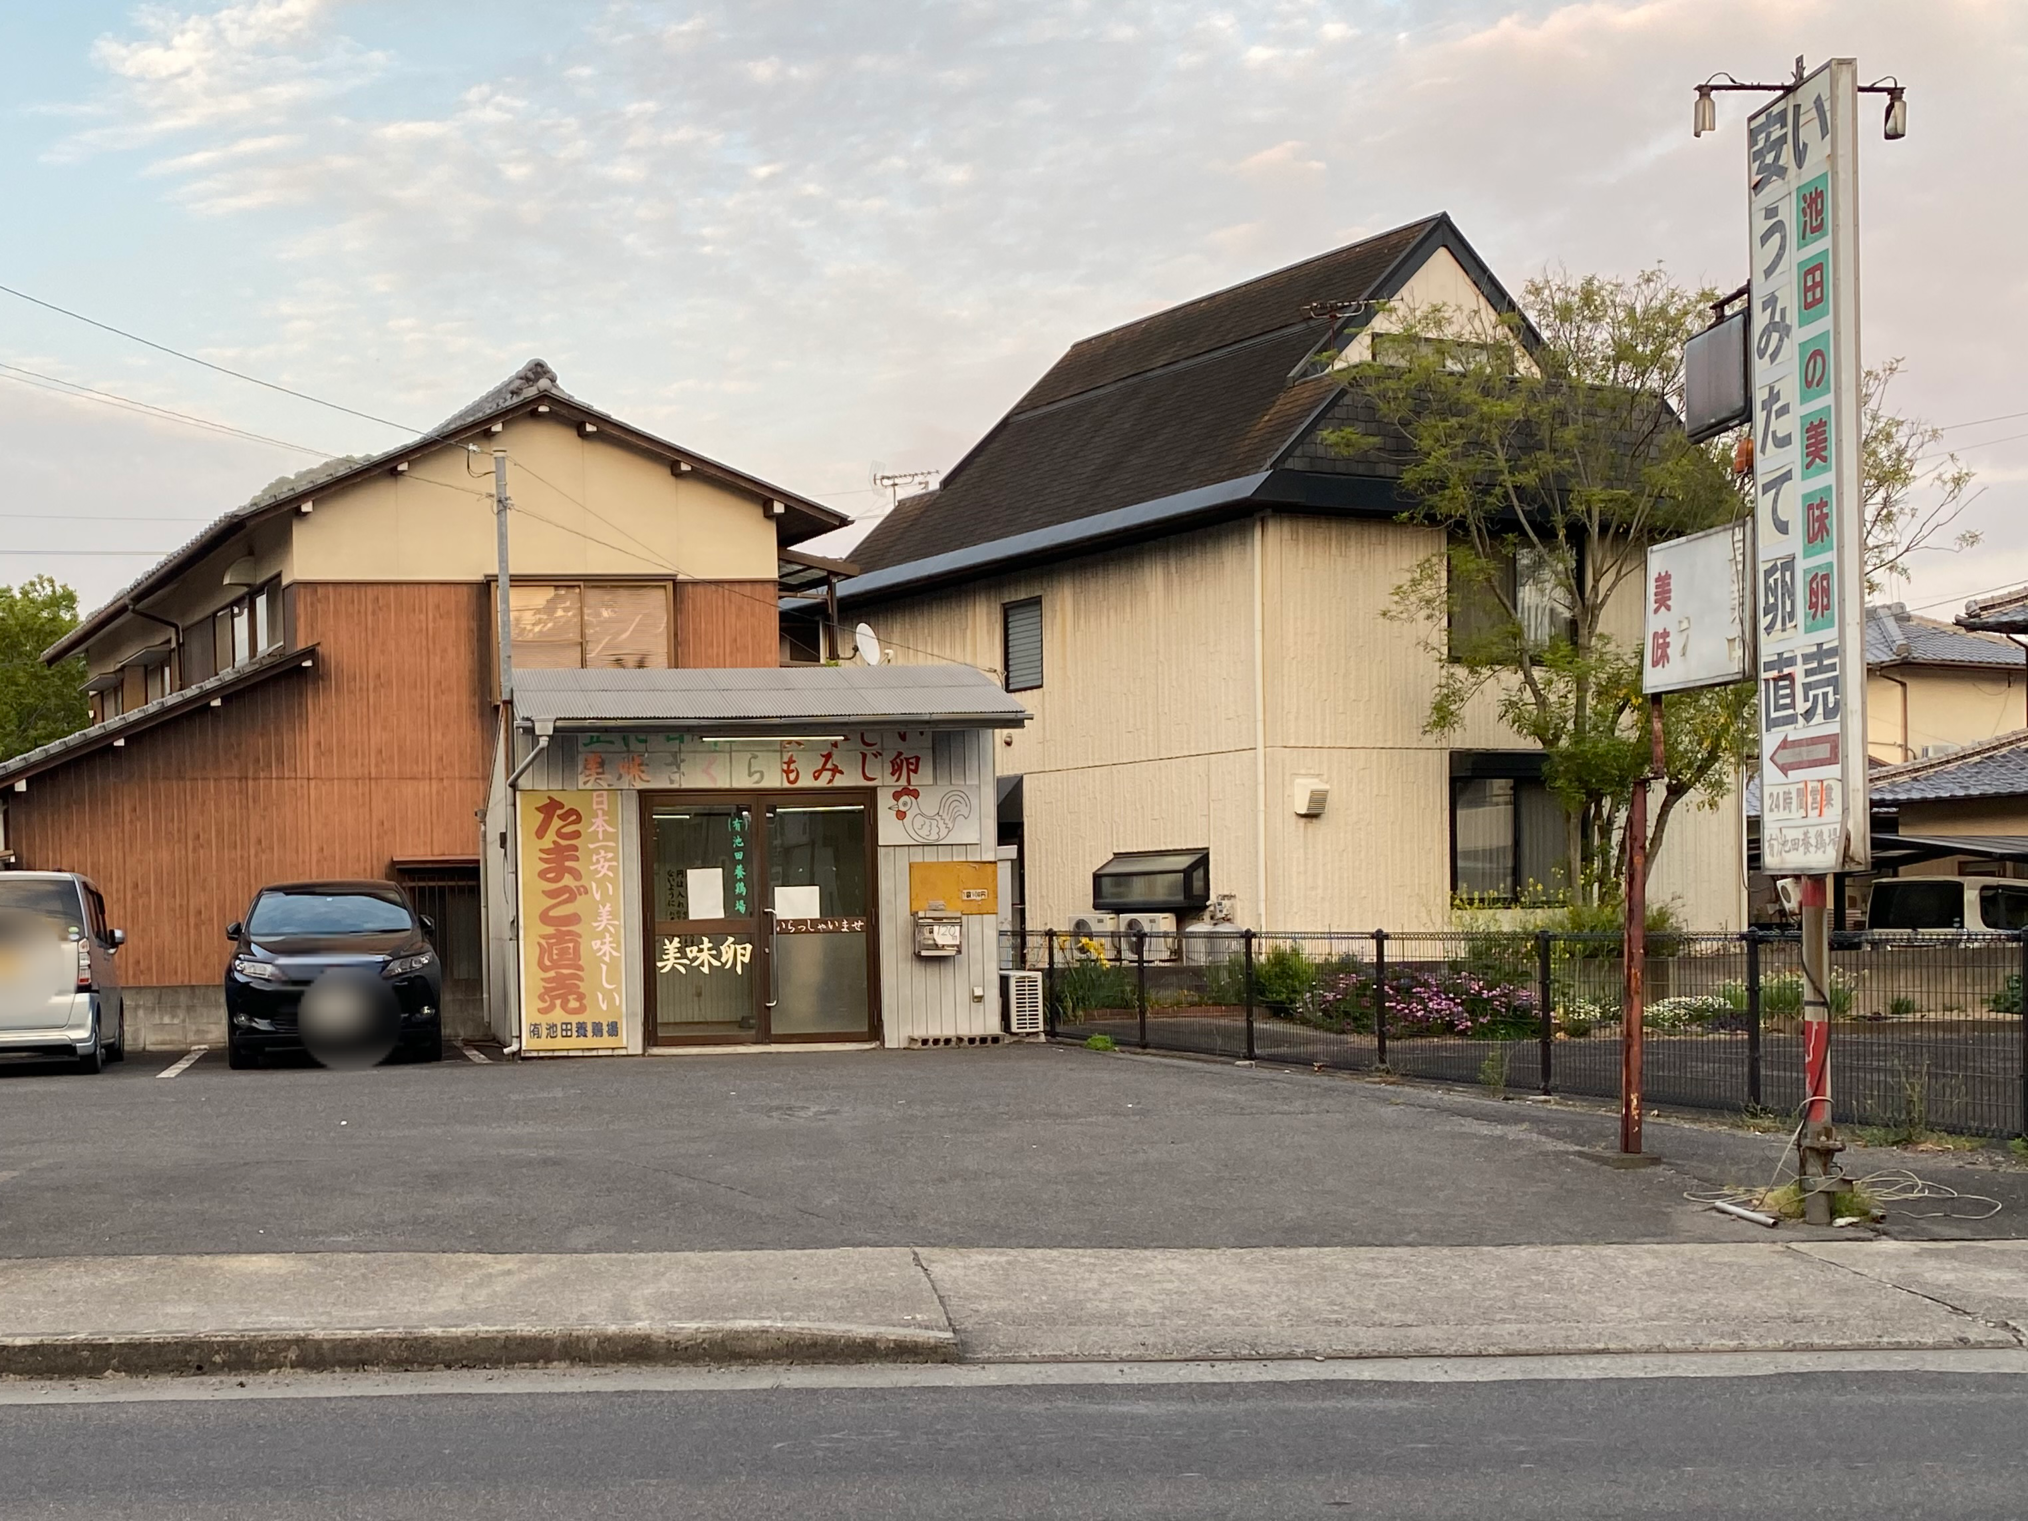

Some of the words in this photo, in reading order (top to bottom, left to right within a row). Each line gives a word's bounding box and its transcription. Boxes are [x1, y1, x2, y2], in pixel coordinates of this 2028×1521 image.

[1751, 93, 1829, 196] 安い
[1801, 185, 1831, 621] 池田の美味卵
[1763, 643, 1840, 732] 直売
[1768, 783, 1834, 814] 24時間営業
[535, 795, 588, 1015] たまご直売
[587, 791, 620, 1011] 日本一安い美味しい
[656, 936, 753, 975] 美味卵
